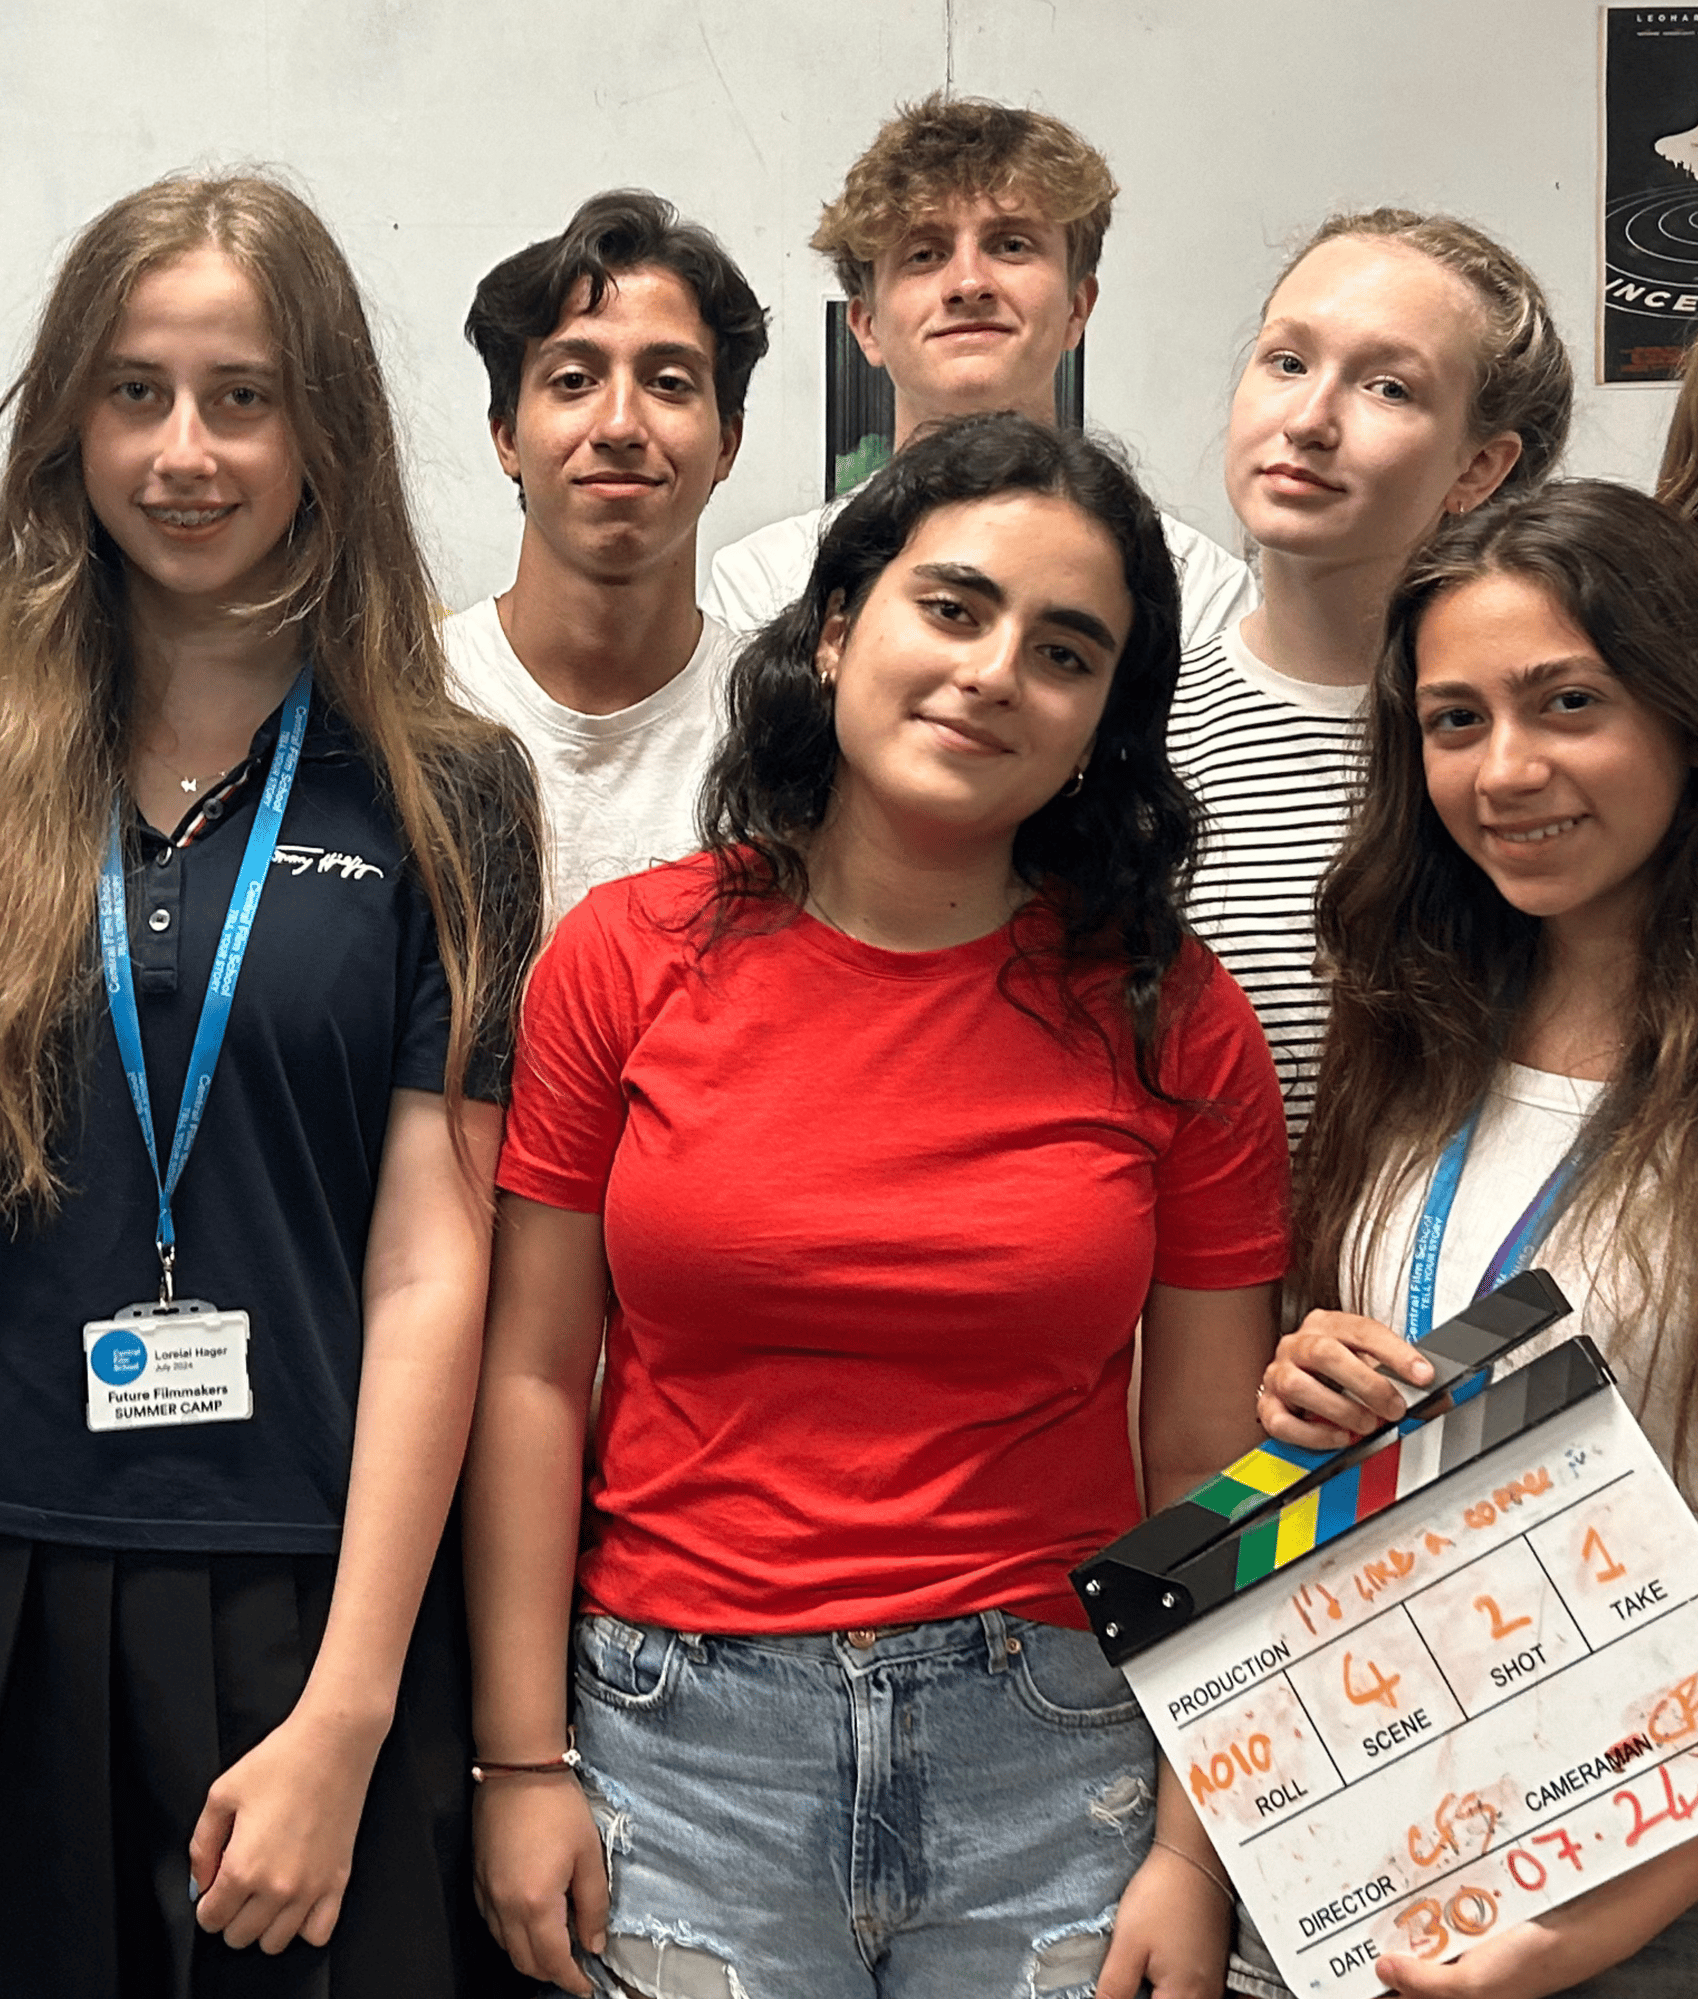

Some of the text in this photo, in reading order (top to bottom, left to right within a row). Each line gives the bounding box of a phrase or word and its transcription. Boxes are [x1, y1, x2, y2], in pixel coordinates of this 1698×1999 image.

[272, 772, 291, 813] School
[220, 880, 262, 997] Central Film School
[1410, 1263, 1424, 1292] Film
[1421, 1217, 1443, 1310] TELL YOUR STORY
[1405, 1295, 1420, 1343] Central
[108, 1384, 228, 1403] Future Filmmakers
[115, 1400, 223, 1419] SUMMER CAMP
[1581, 1526, 1628, 1584] 1
[1473, 1594, 1533, 1640] 2
[1610, 1579, 1669, 1624] TAKE
[1168, 1640, 1291, 1722] PRODUCTION
[1342, 1651, 1401, 1709] 4
[1490, 1644, 1549, 1689] SHOT
[1363, 1707, 1433, 1758] SCENE
[1525, 1733, 1654, 1812] CAMERAMAN
[1255, 1778, 1309, 1818] ROLL
[1299, 1875, 1397, 1938] DIRECTOR
[1329, 1938, 1382, 1979] DATE
